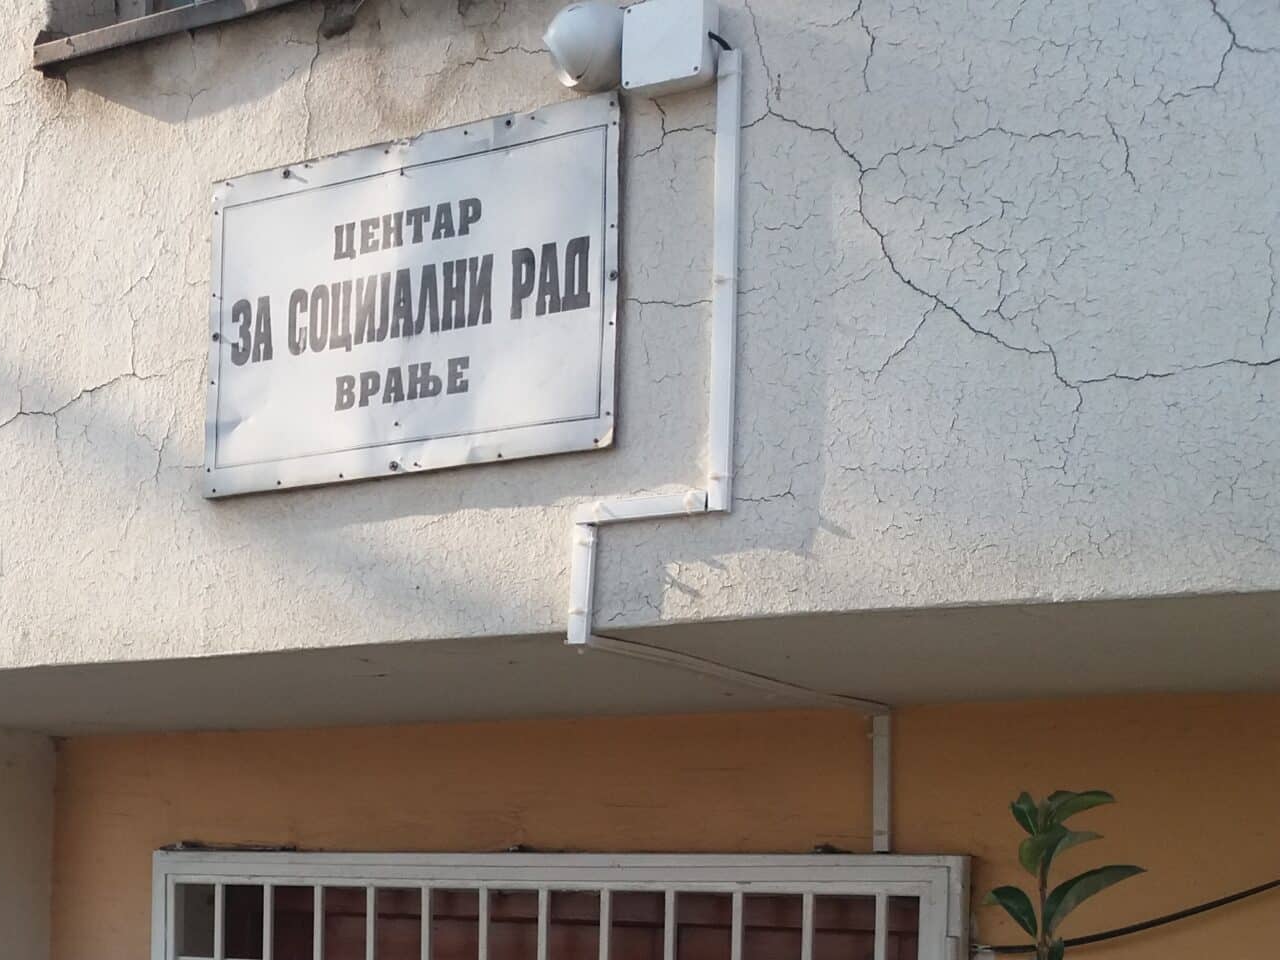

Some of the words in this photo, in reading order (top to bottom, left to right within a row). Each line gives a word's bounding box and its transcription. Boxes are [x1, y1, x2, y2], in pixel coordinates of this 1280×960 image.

[334, 197, 482, 261] ЦЕНТАР
[230, 296, 274, 366] ЗА
[287, 253, 494, 356] СОЦИЈАЛНИ
[510, 236, 592, 321] РАД
[334, 356, 471, 412] ВРАЊЕ
